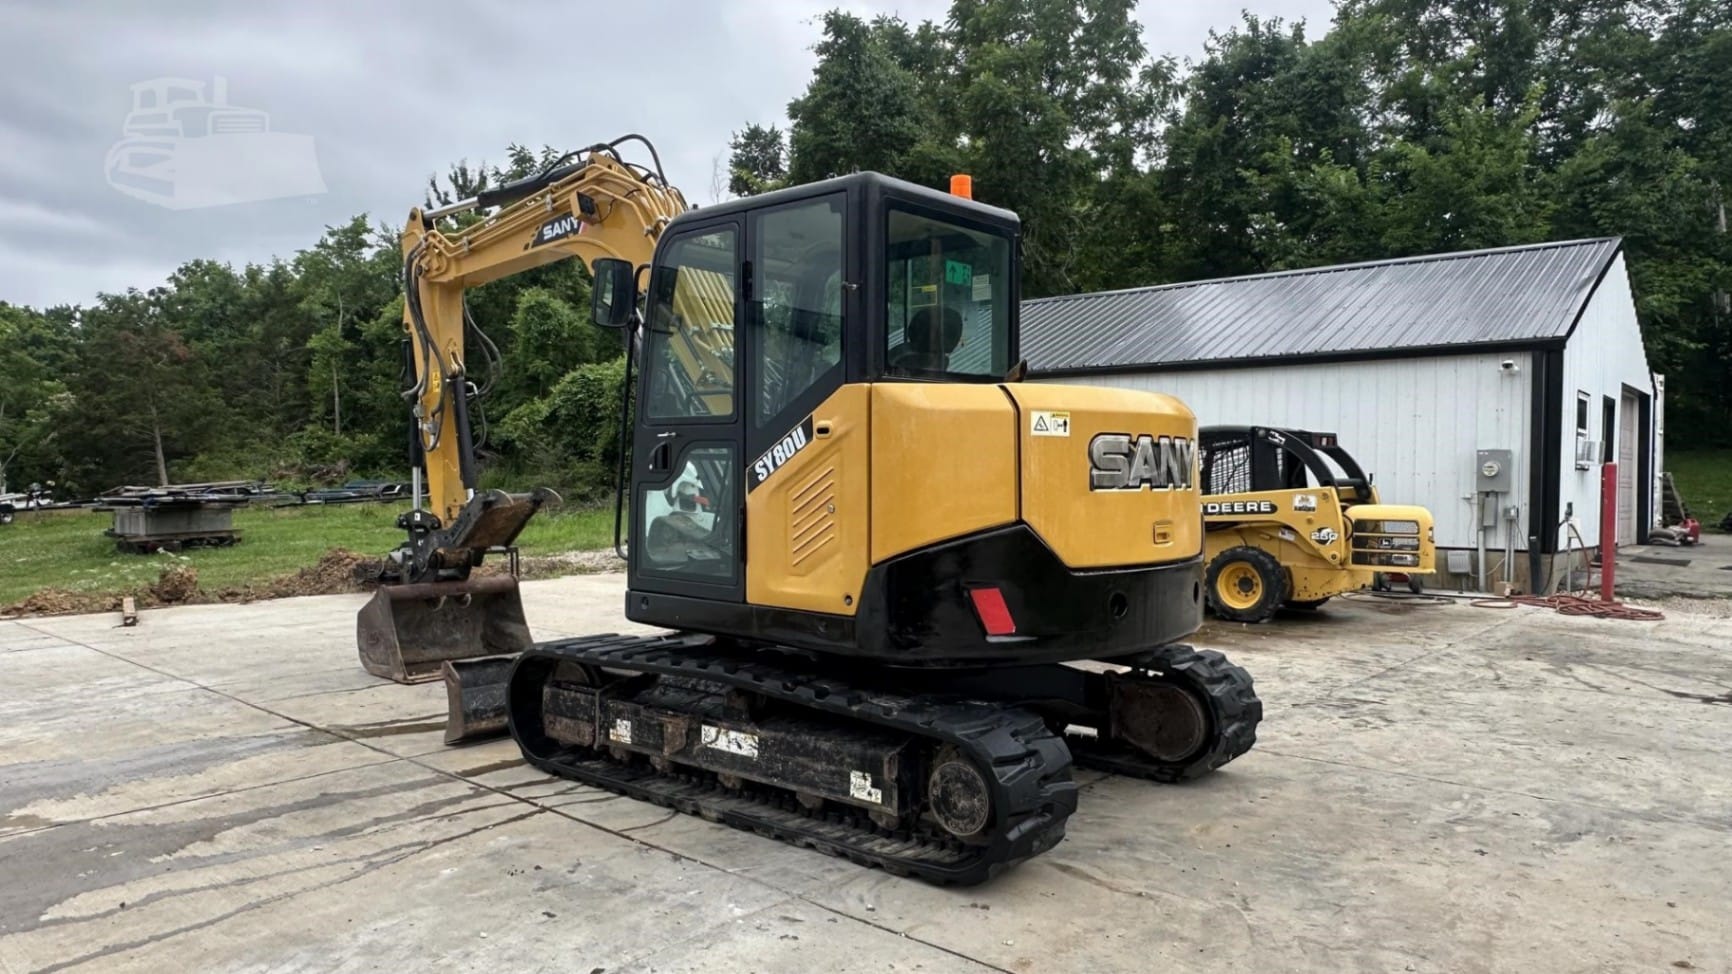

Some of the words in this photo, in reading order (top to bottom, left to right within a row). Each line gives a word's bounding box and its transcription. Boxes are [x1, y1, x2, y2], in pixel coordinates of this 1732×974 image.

[543, 216, 578, 240] SANY
[754, 425, 807, 482] SY80U
[1088, 432, 1195, 490] SANY
[1207, 501, 1272, 513] DEERE
